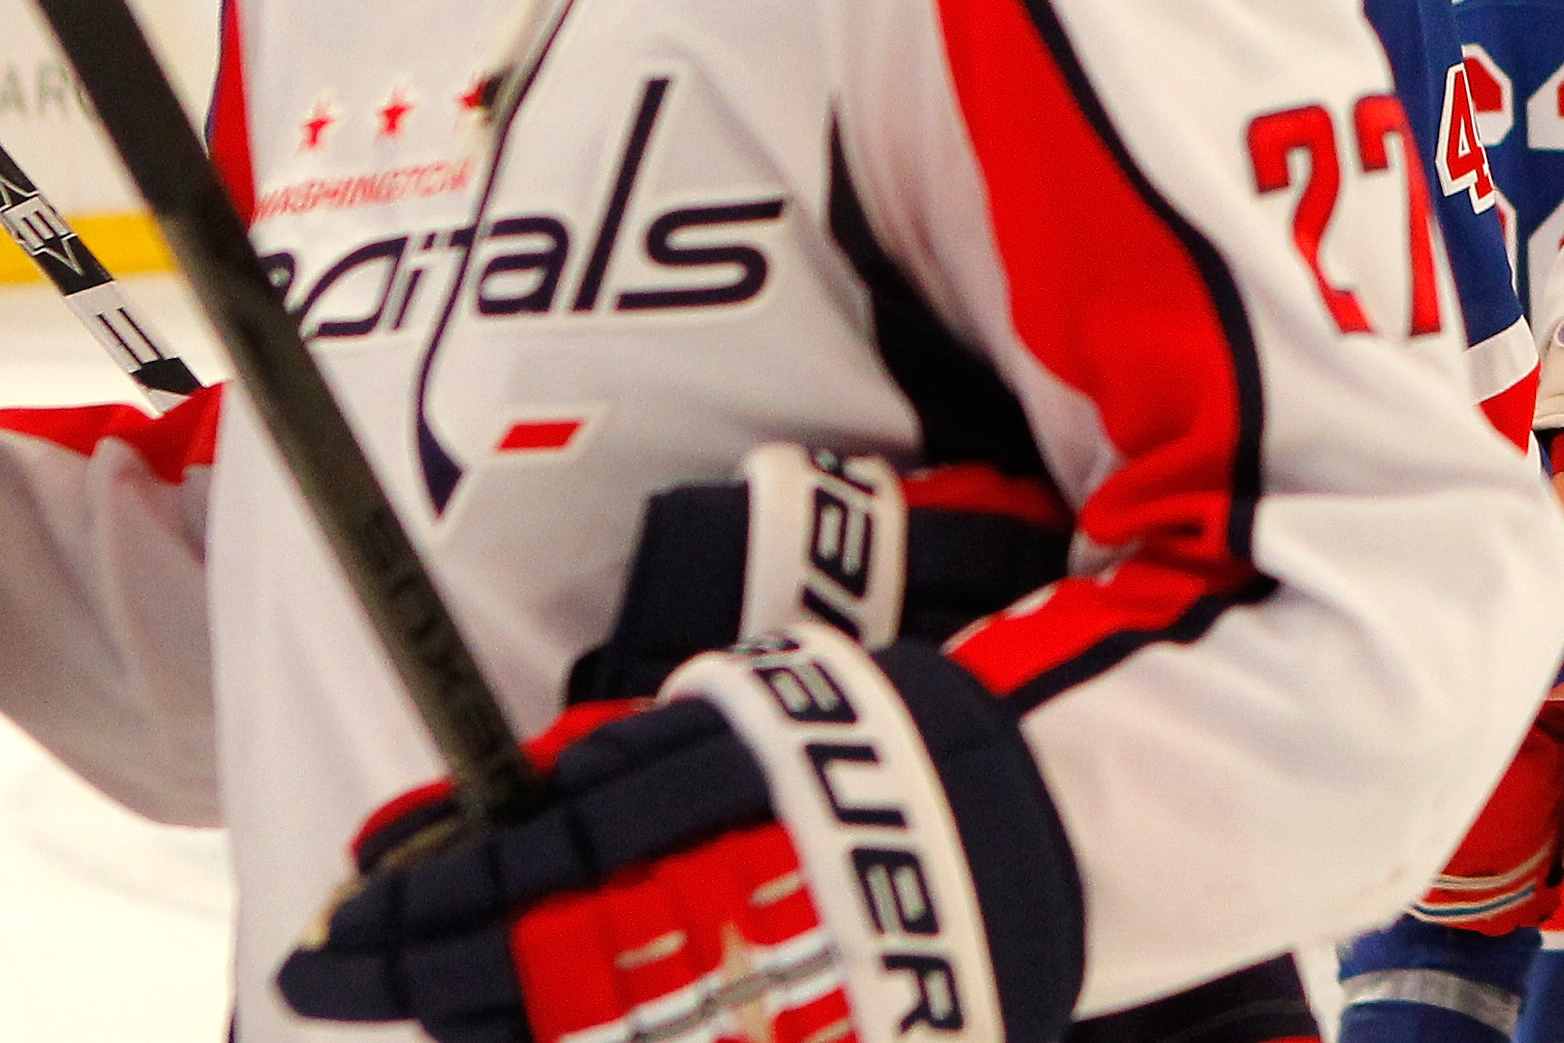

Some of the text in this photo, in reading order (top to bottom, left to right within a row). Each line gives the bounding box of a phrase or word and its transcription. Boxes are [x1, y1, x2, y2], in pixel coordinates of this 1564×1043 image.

[1246, 92, 1443, 337] 27
[1435, 62, 1496, 214] 4
[742, 636, 965, 1032] AUER
